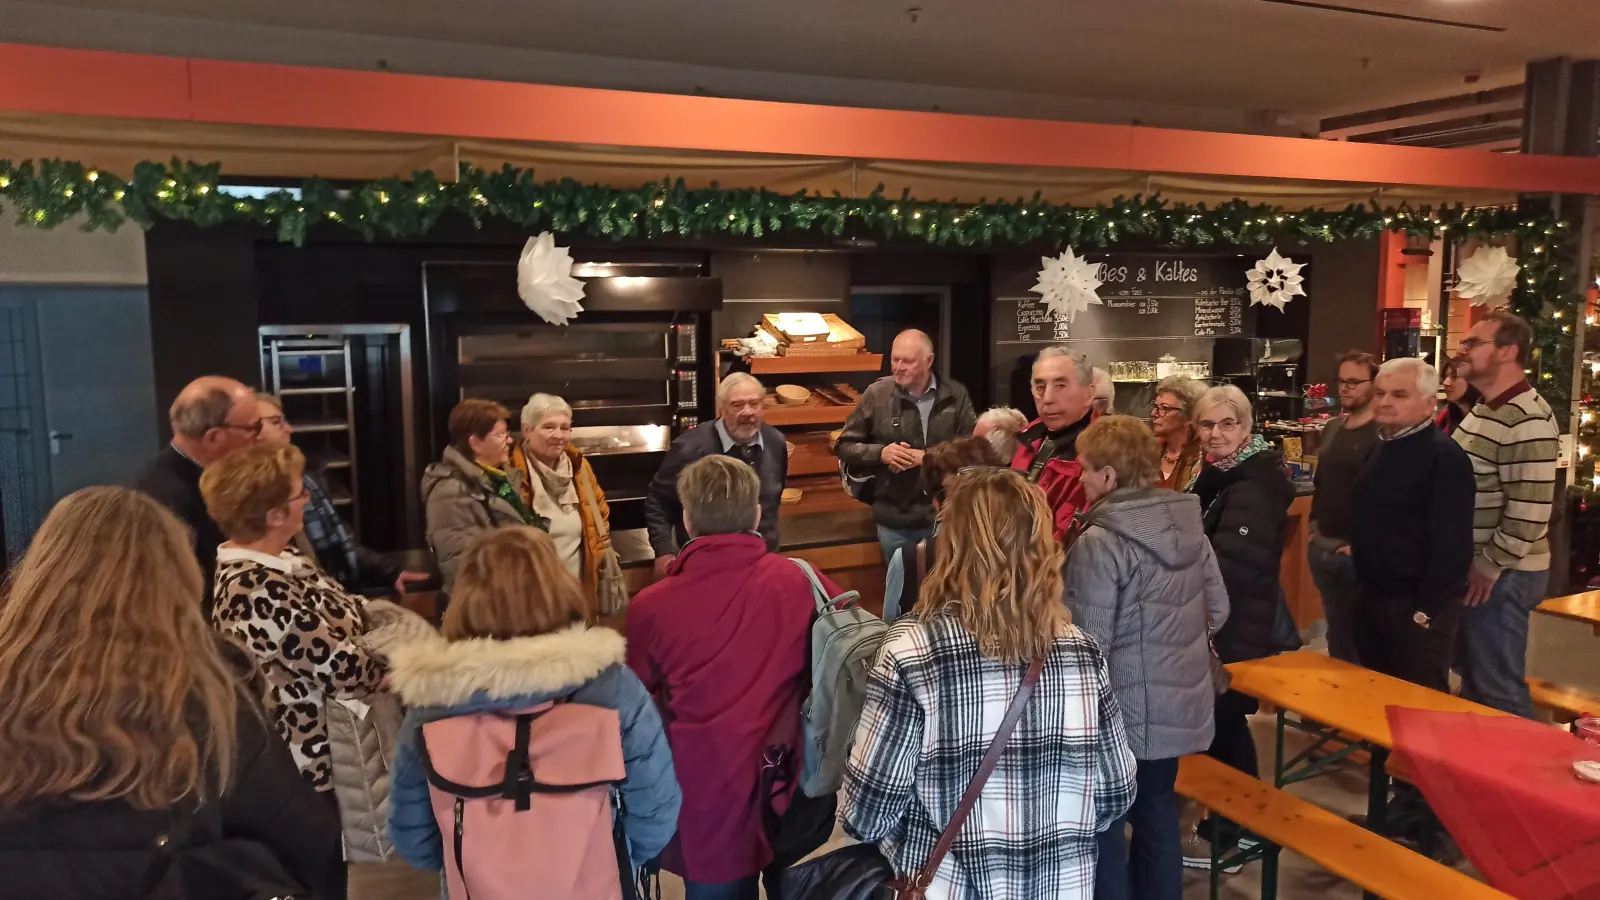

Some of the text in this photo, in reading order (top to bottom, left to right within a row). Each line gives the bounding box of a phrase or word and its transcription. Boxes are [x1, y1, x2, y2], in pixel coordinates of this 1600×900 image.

[1136, 267, 1147, 283] &
[1155, 260, 1198, 283] Kaltes
[1017, 299, 1036, 309] Kaffee
[1018, 330, 1070, 341] Tee 2,50€
